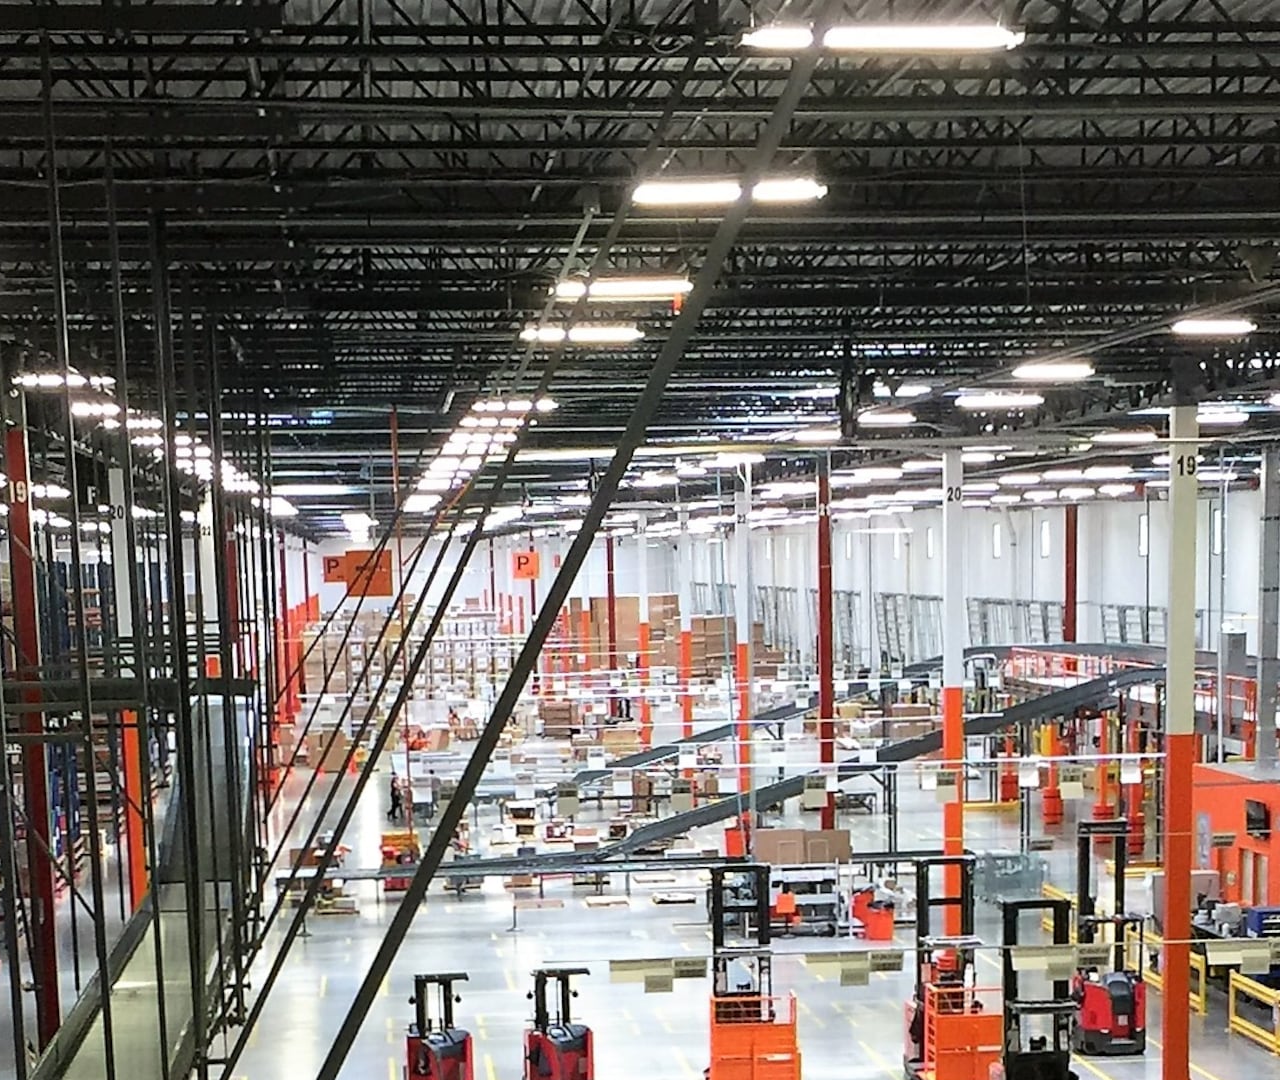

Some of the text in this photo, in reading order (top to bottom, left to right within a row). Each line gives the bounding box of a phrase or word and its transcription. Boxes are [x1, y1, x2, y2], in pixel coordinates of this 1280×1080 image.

[1177, 455, 1196, 476] 19
[10, 480, 27, 503] 19
[947, 486, 961, 502] 20
[109, 505, 124, 519] 20
[327, 559, 339, 574] P
[518, 556, 529, 570] P
